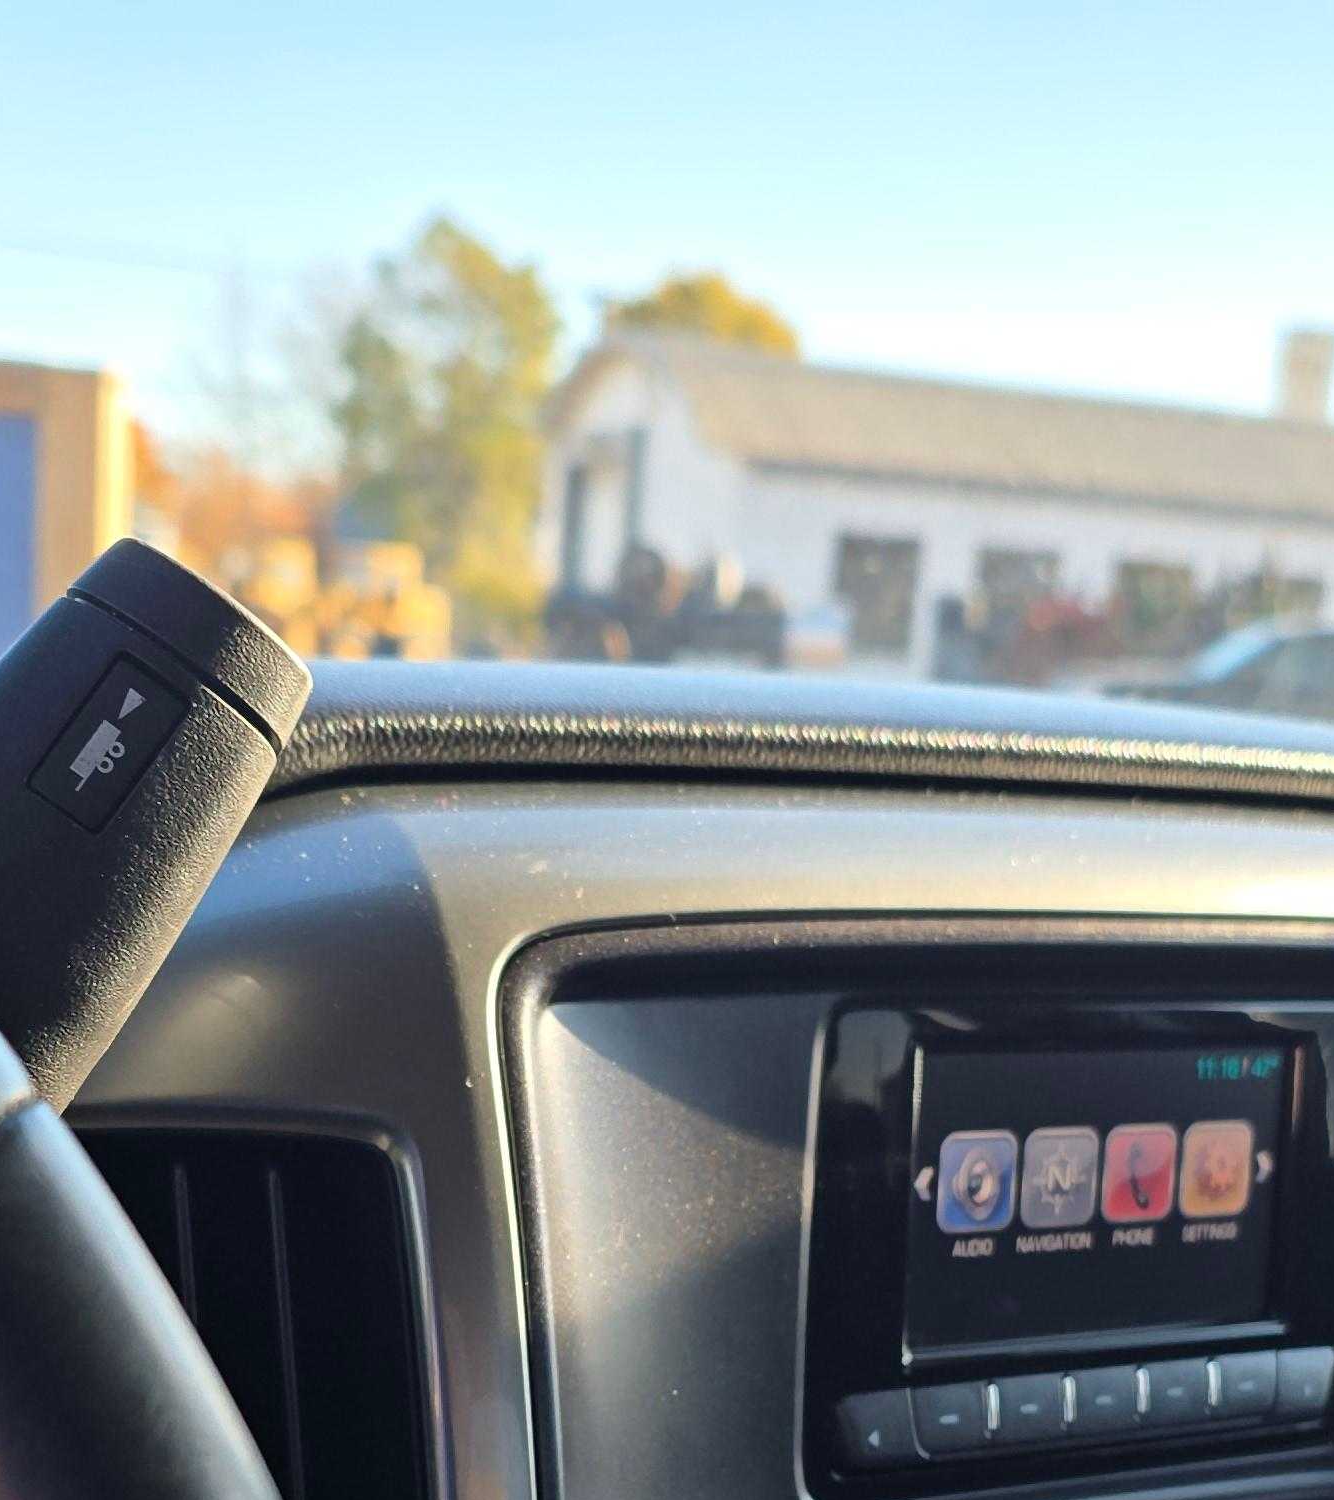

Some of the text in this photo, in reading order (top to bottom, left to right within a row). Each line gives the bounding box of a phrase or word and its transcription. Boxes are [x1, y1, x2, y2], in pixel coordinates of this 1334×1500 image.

[952, 1237, 994, 1257] AUDIO
[1016, 1232, 1092, 1256] NAVIGATION
[1112, 1227, 1154, 1247] PHONE
